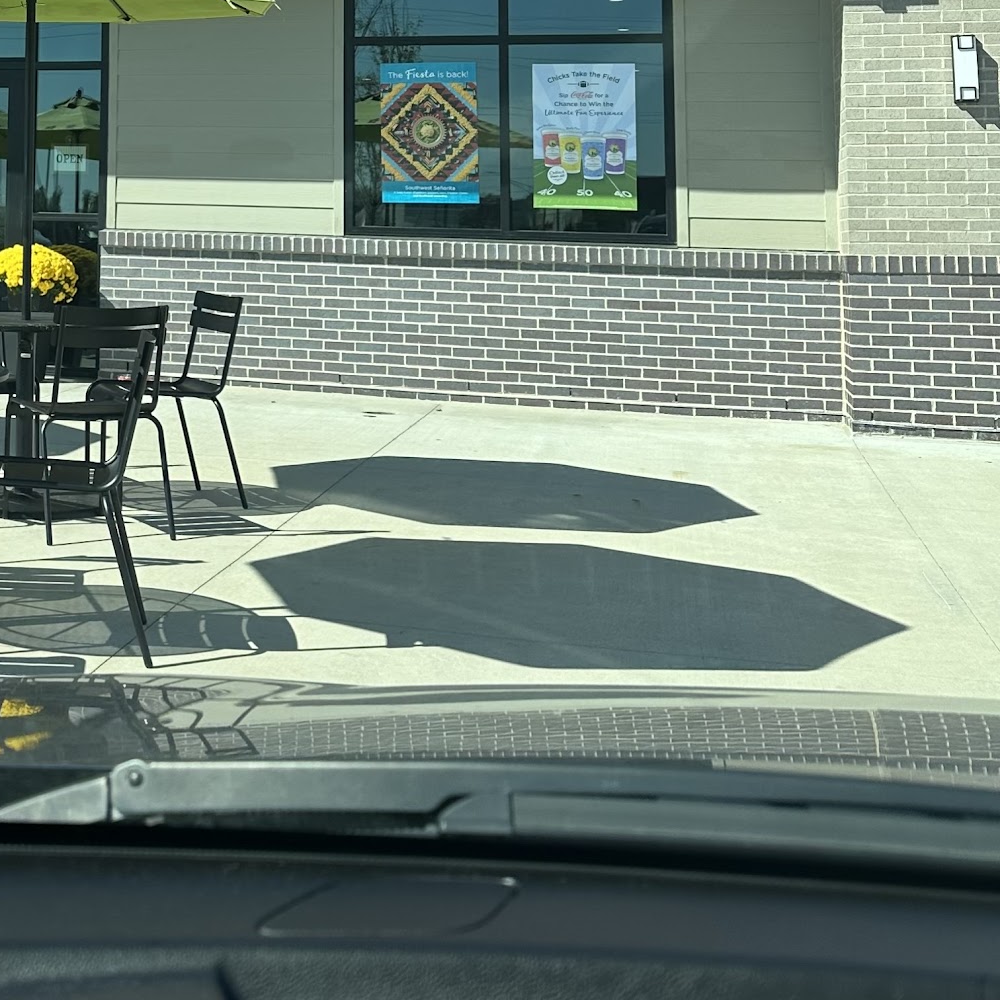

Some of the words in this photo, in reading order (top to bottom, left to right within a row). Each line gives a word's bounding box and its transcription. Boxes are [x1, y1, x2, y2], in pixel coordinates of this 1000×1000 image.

[388, 71, 403, 79] The
[405, 68, 435, 80] Fiesta
[446, 70, 469, 78] back!
[547, 73, 570, 84] Chicks
[602, 73, 621, 84] Field
[588, 109, 624, 117] Experience
[56, 153, 84, 164] OPEN
[537, 188, 557, 196] 40
[576, 188, 594, 197] 50
[613, 190, 633, 198] 40
